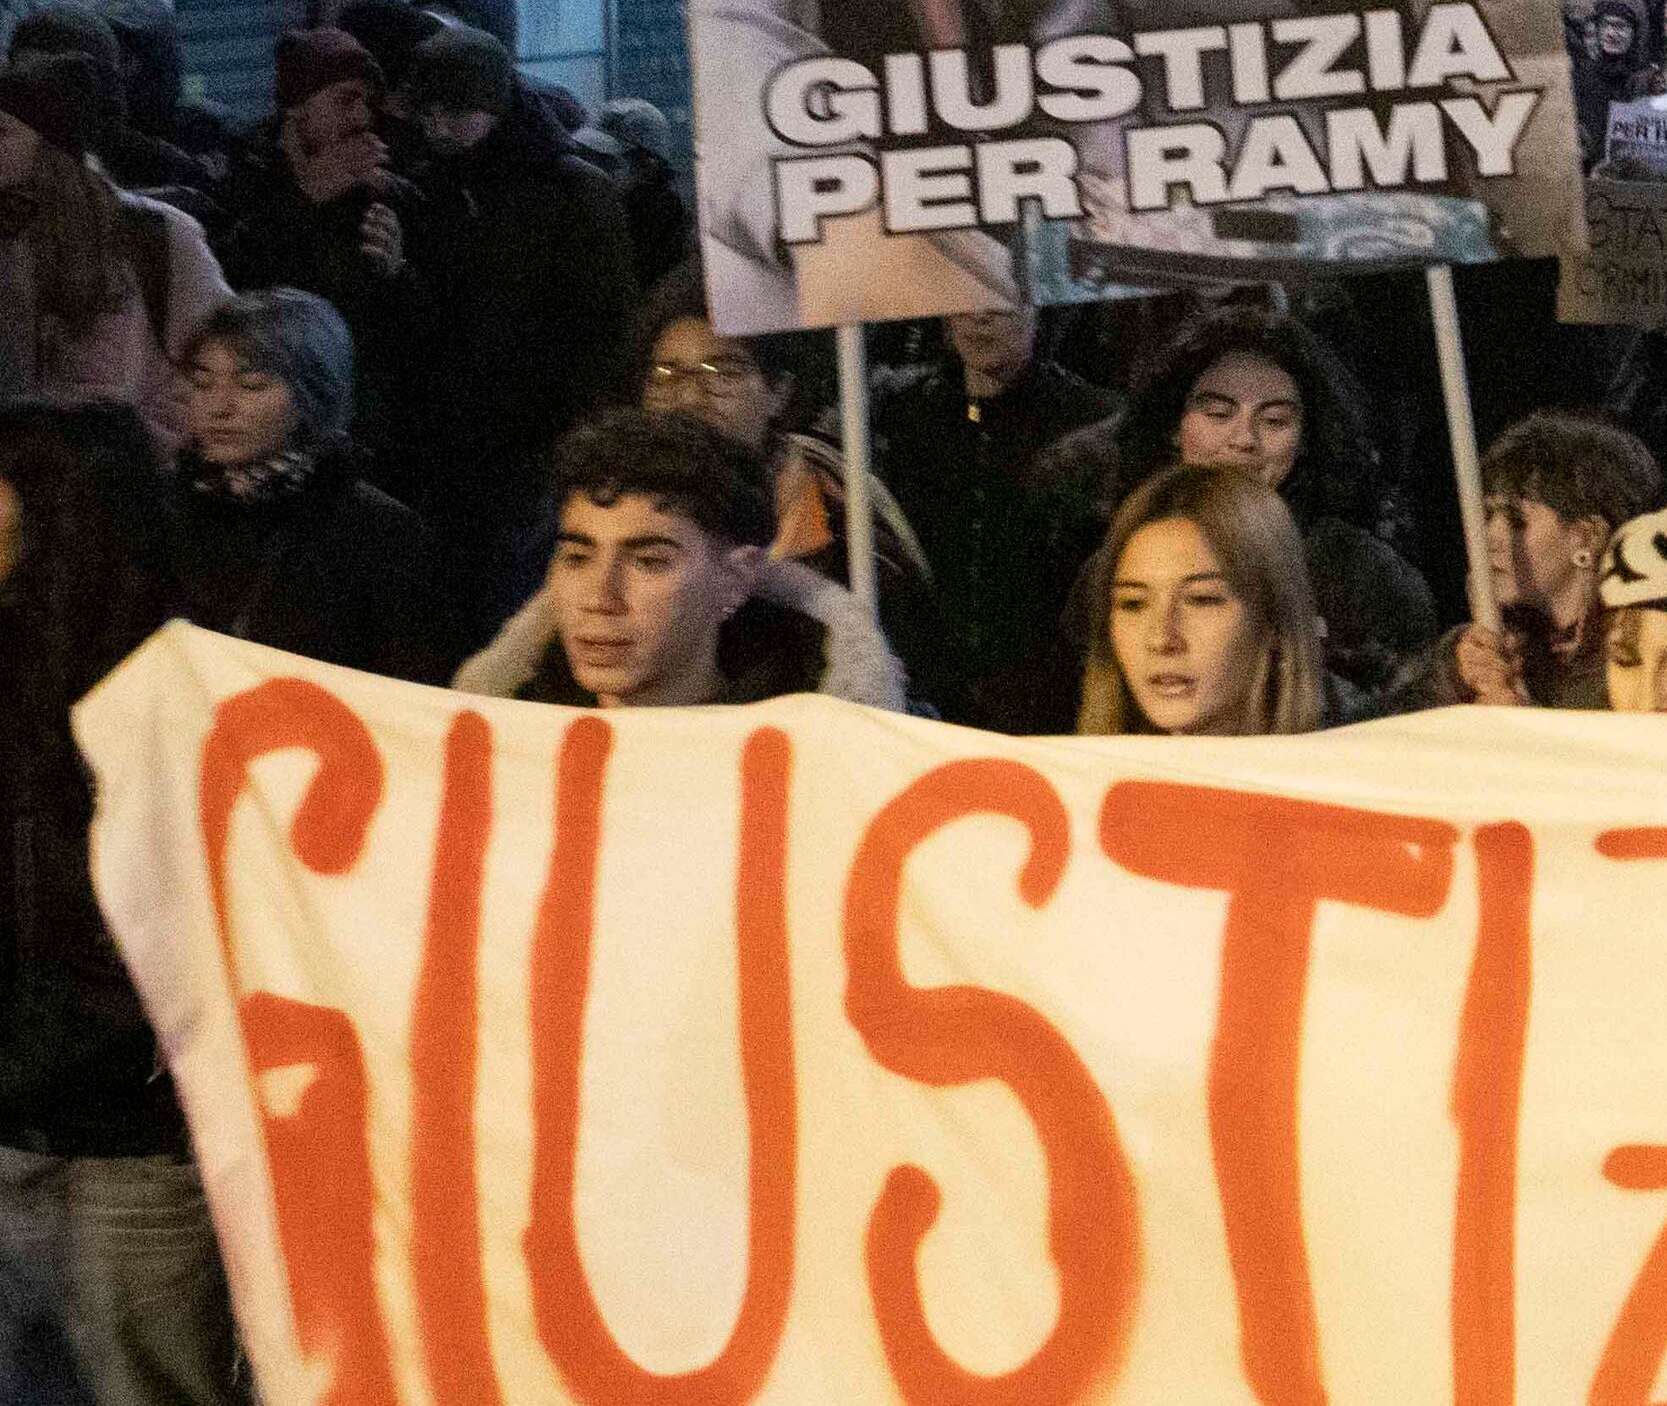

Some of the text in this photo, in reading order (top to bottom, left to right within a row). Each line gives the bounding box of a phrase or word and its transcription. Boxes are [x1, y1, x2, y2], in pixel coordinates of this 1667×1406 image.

[767, 2, 1513, 146] GIUSTIZIA
[774, 90, 1541, 245] PER RAMY
